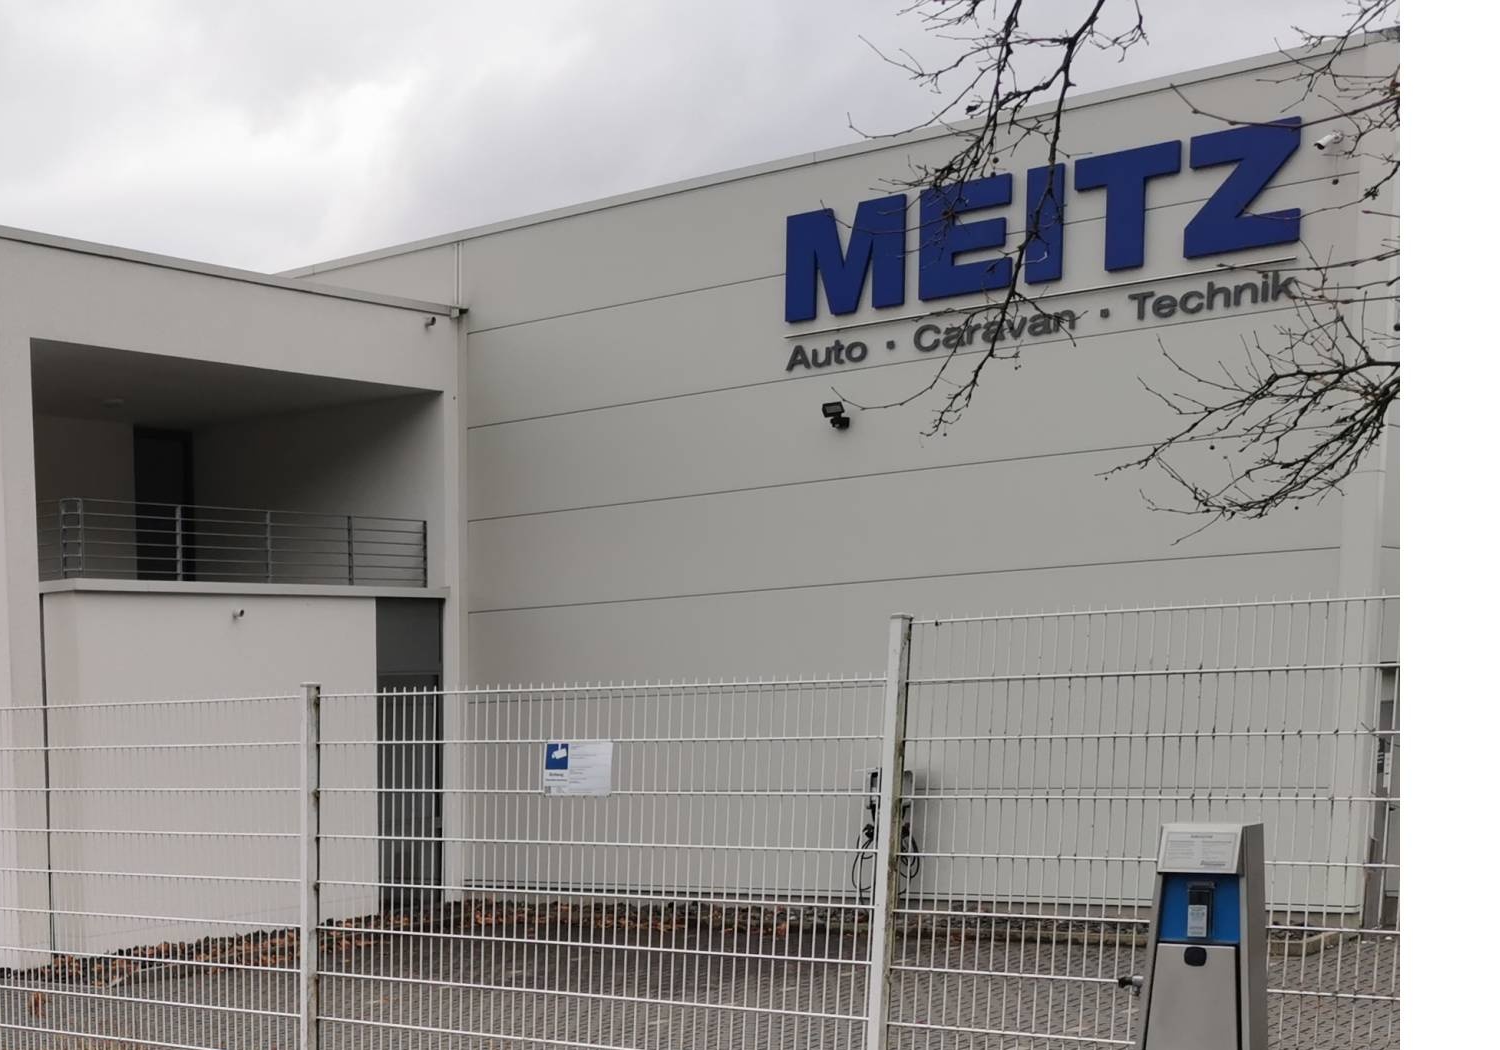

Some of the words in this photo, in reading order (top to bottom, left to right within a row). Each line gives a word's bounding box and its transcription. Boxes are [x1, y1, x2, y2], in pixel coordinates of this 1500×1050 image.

[785, 116, 1302, 322] MEITZ
[786, 337, 868, 372] Auto
[913, 306, 1076, 353] Caravan
[1128, 271, 1297, 321] Technik
